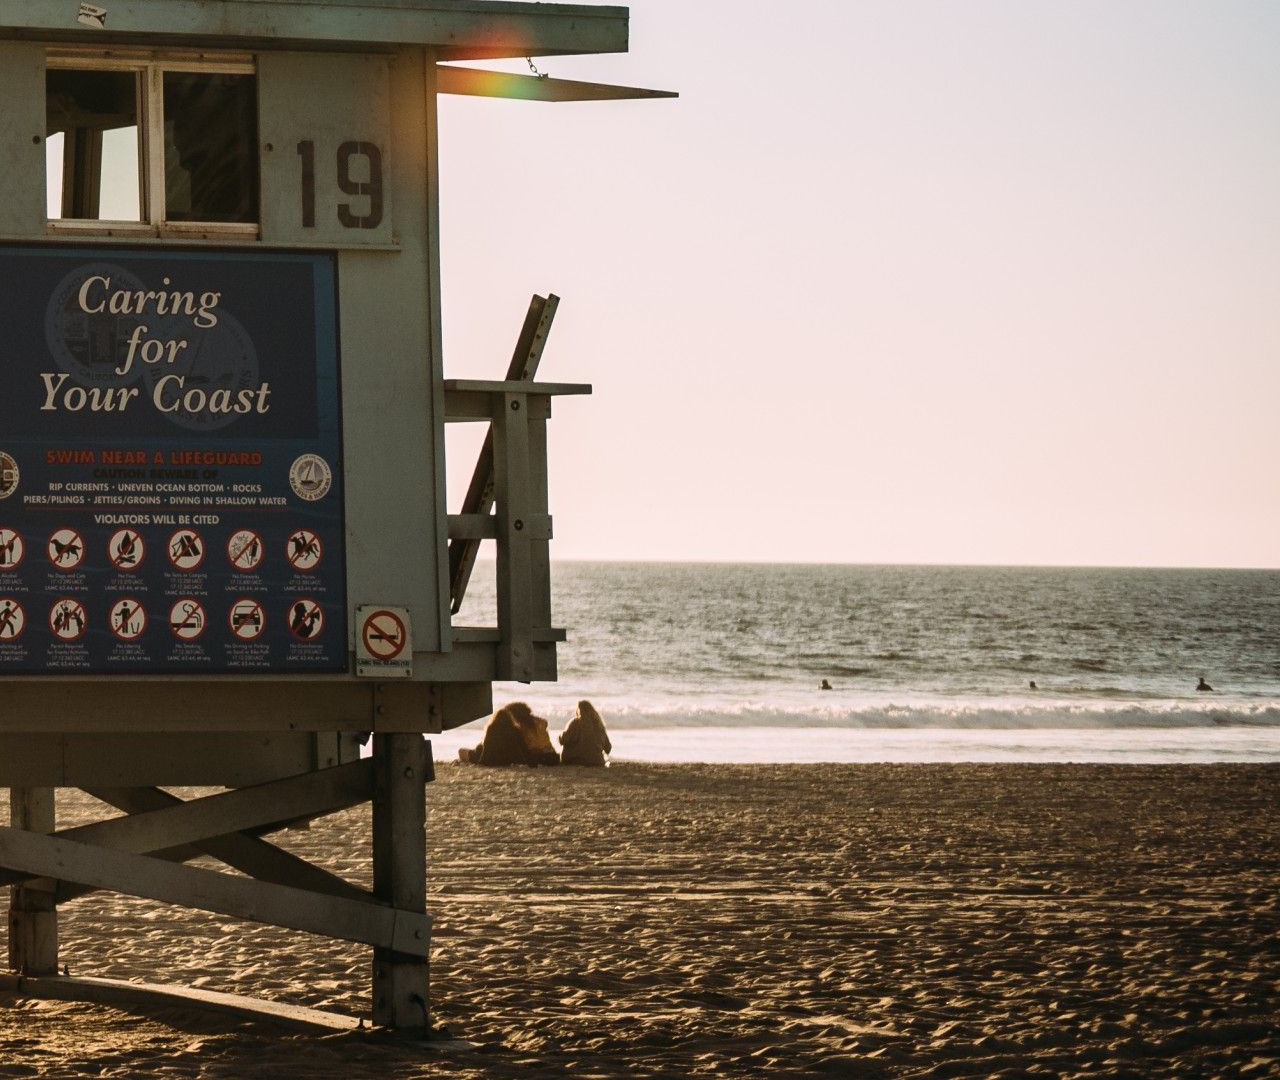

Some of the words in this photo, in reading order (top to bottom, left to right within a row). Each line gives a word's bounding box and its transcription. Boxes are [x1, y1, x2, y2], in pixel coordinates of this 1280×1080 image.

[297, 140, 383, 229] 19
[78, 276, 221, 329] Caring
[115, 325, 187, 375] for
[40, 373, 138, 411] Your
[153, 374, 272, 414] Coast
[47, 450, 96, 464] SWIM
[102, 451, 147, 465] NEAR
[153, 451, 167, 465] A
[171, 451, 262, 466] LIFEGUARD
[93, 469, 146, 479] CAUTION
[150, 469, 199, 479] BEWARE
[203, 470, 219, 479] OF
[49, 483, 63, 491] RIP
[65, 483, 109, 491] CURRENTS
[118, 483, 153, 492] UNEVEN
[156, 484, 187, 492] OCEAN
[189, 484, 224, 493] BOTTOM
[233, 484, 262, 493] ROCKS
[24, 495, 85, 505] PIERS/PILINGS
[94, 496, 161, 505] JETTIES/GROINS
[170, 497, 201, 505] DIVING
[204, 497, 213, 505] IN
[216, 497, 257, 506] SHALLOW
[259, 497, 287, 506] WATER
[94, 515, 151, 525] VIOLATORS
[153, 515, 176, 525] WILL
[179, 515, 191, 525] BE
[193, 515, 220, 525] CITED
